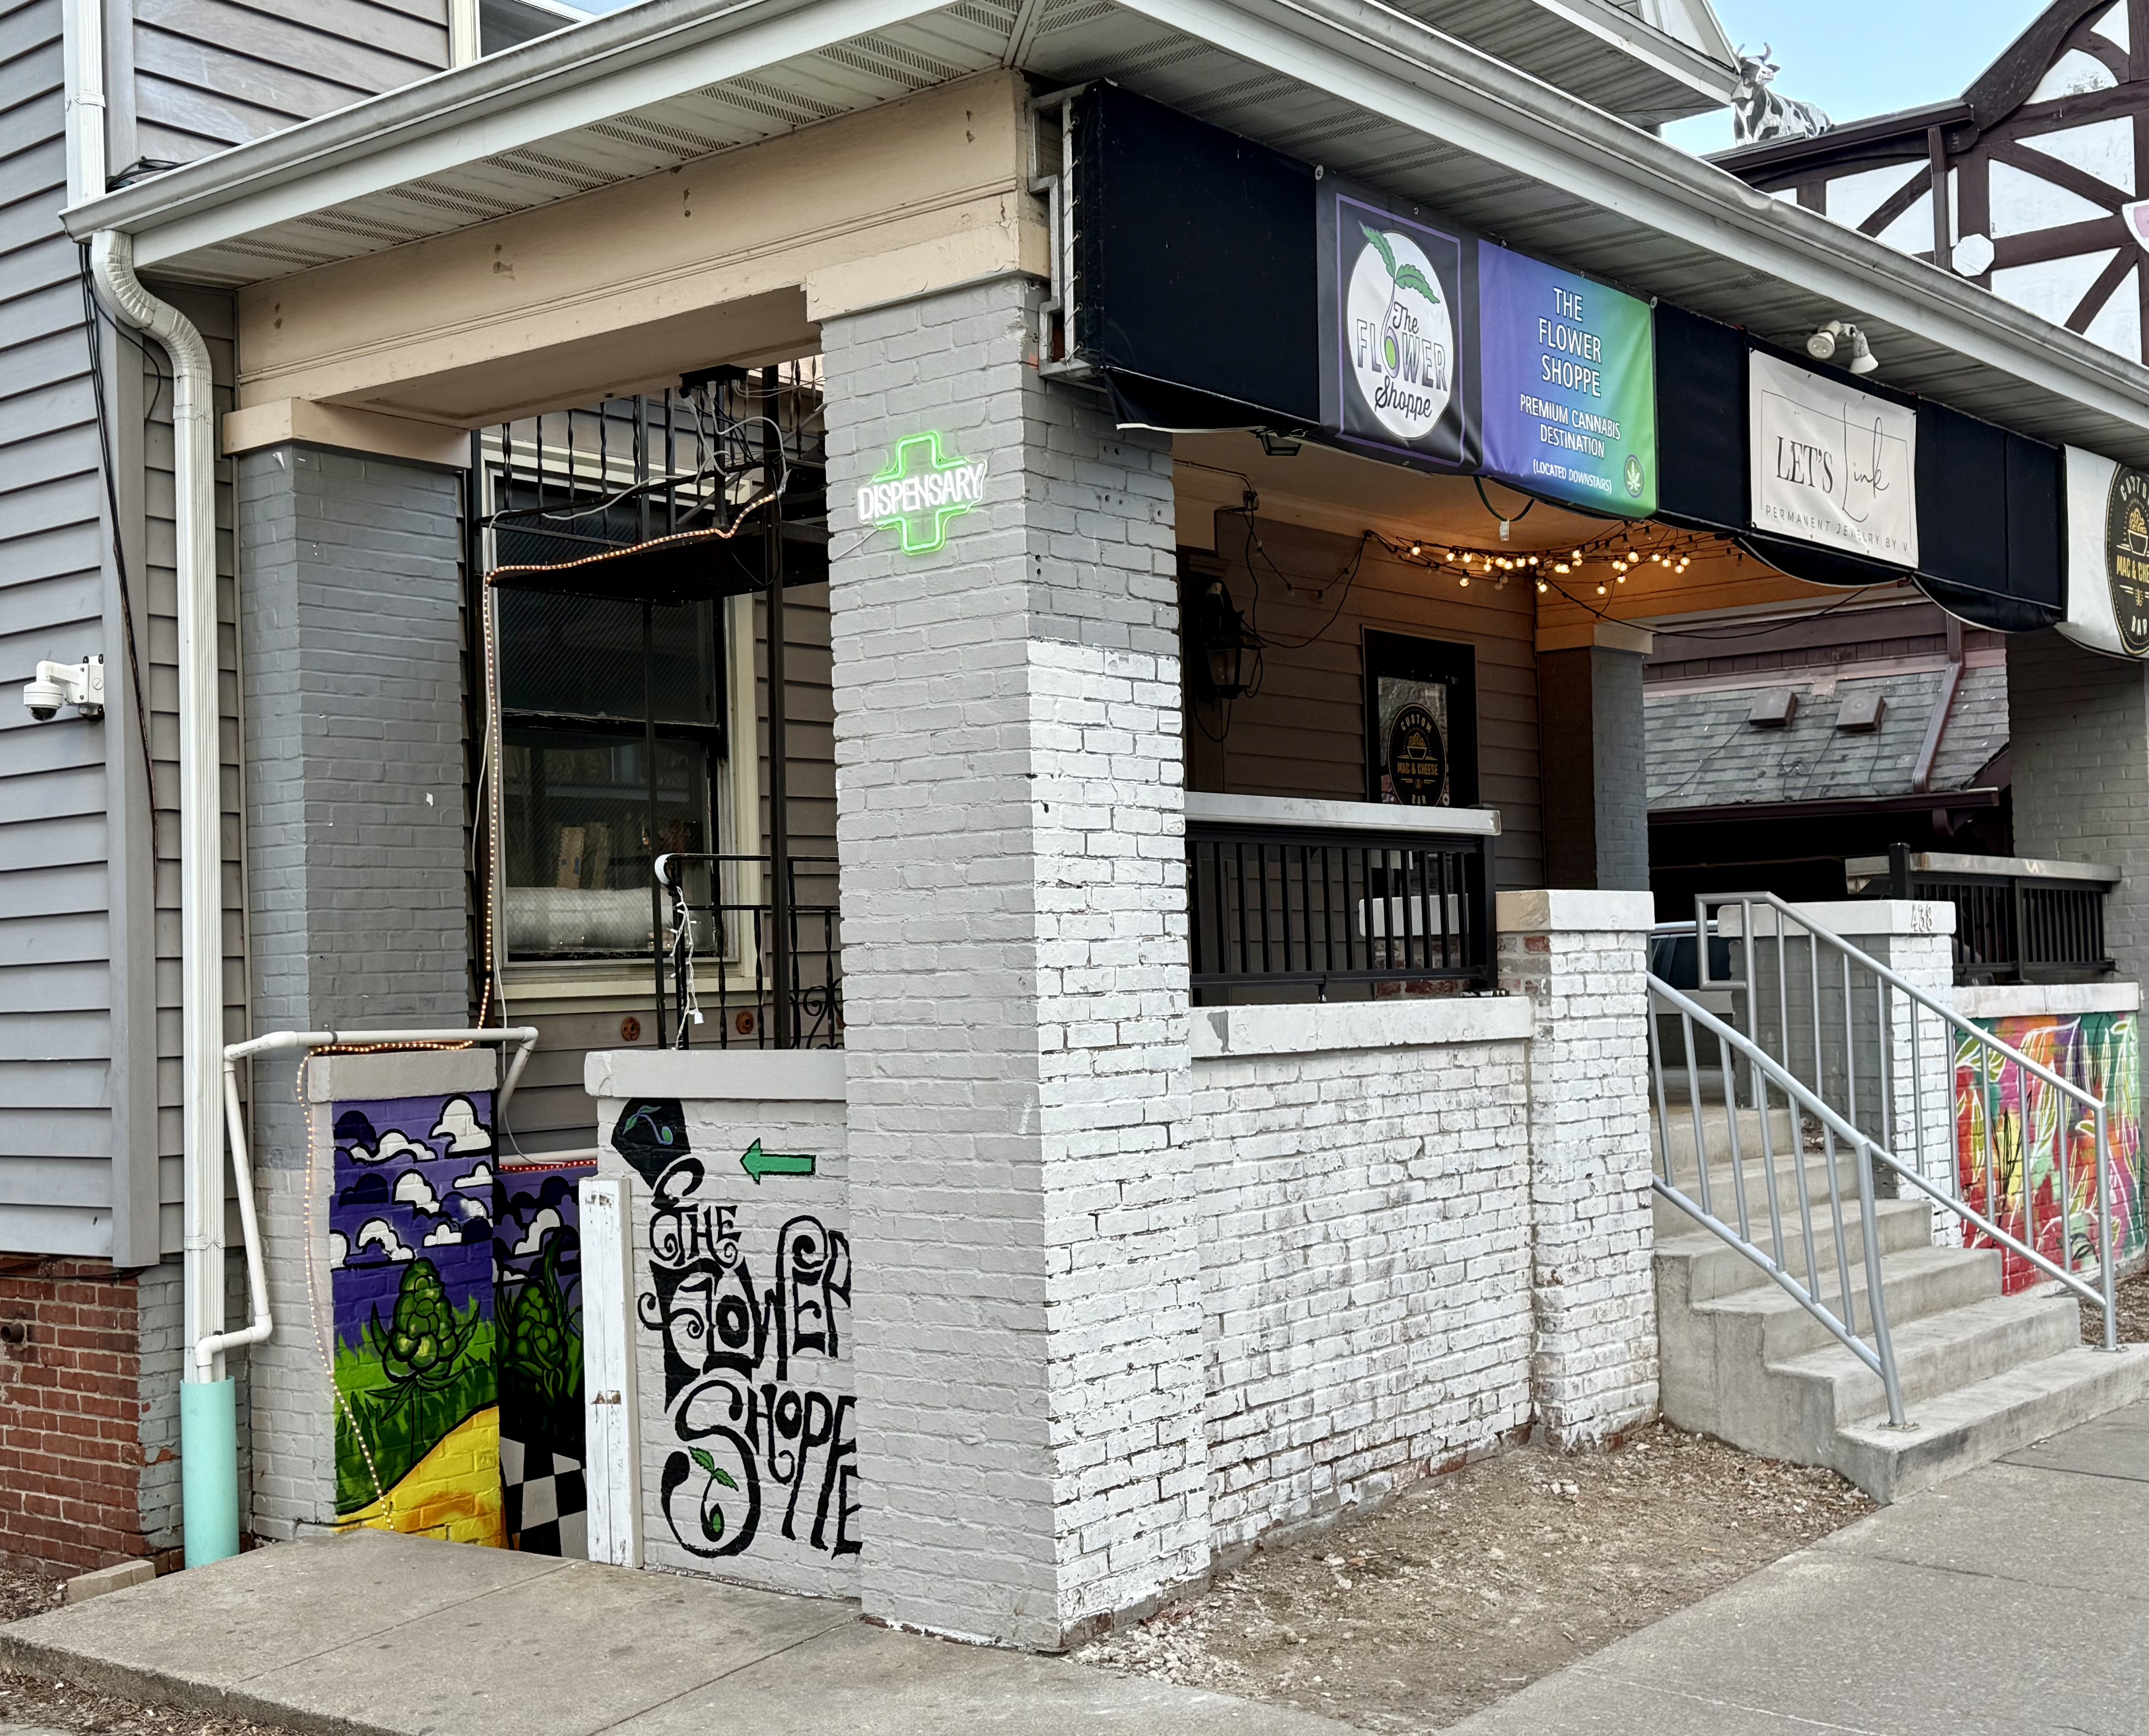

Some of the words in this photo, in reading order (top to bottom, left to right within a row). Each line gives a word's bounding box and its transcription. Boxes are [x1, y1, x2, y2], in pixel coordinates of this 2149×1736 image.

[1392, 301, 1419, 334] The
[1553, 287, 1583, 322] THE
[1356, 318, 1447, 392] FLOWER
[1538, 317, 1601, 363] FLOWER
[1541, 354, 1601, 398] SHOPPE
[1375, 375, 1432, 421] Shoppe
[1520, 393, 1568, 425] PREMIUM
[1572, 409, 1621, 440] CANNABIS
[1540, 423, 1605, 458] DESTINATION
[1533, 458, 1567, 480] (LOCATED
[1568, 468, 1612, 494] DOWNSTAIRS)
[1776, 435, 1833, 493] LET'S
[858, 463, 984, 520] DISPENSARY
[2120, 476, 2149, 501] CUSTO
[1766, 504, 1830, 532] PERMANENT
[1836, 522, 1880, 545] JEWELRY
[1885, 537, 1897, 549] BY
[2116, 555, 2130, 578] MAC
[2132, 560, 2136, 580] &
[2131, 615, 2147, 636] BAR
[1400, 714, 1432, 733] CUSTOM
[1397, 762, 1409, 774] MAC
[1412, 762, 1416, 775] &
[1418, 763, 1438, 776] CHEESE
[1412, 794, 1427, 806] BAR
[649, 1204, 742, 1268] THE
